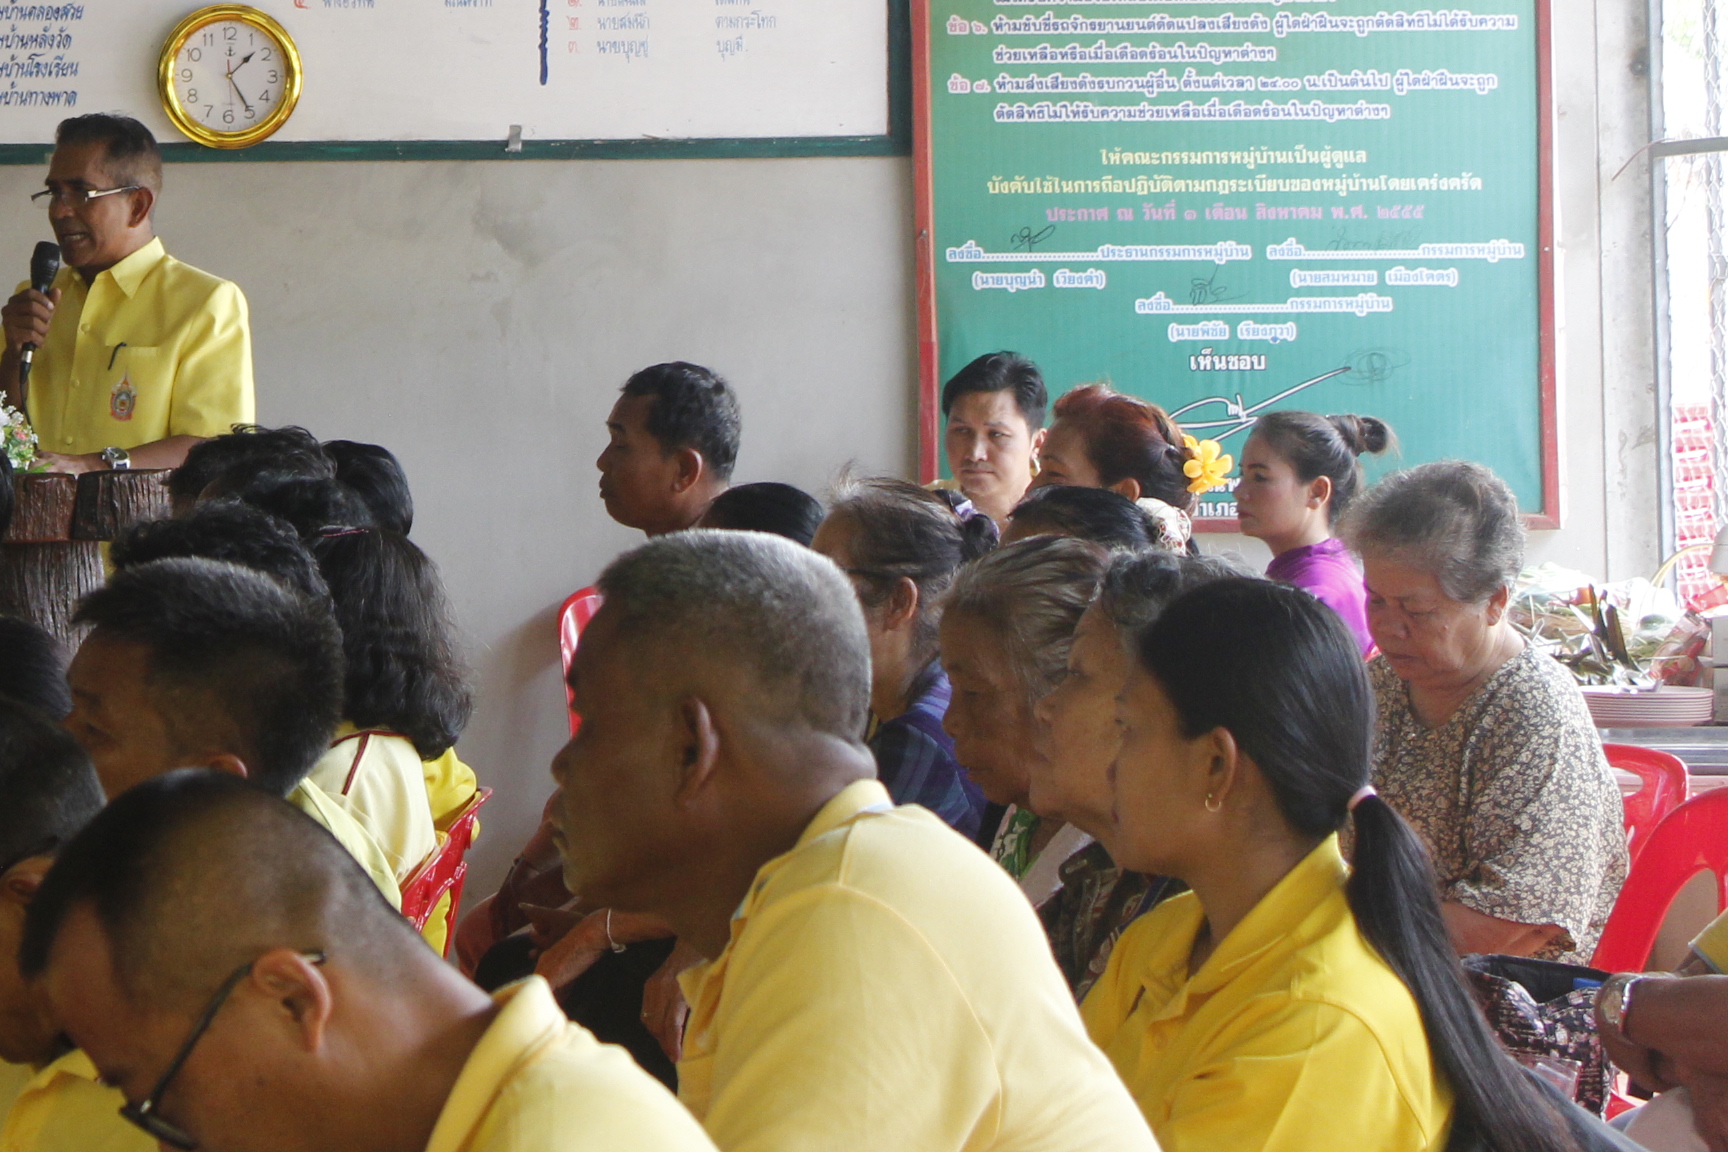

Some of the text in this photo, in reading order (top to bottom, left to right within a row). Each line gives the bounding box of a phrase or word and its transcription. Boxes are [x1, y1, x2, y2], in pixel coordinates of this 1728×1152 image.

[947, 16, 968, 34] ข้อ
[202, 33, 214, 47] 11
[223, 27, 237, 41] 12
[249, 33, 254, 46] 1
[187, 48, 201, 62] 10
[261, 48, 271, 61] 2
[181, 69, 192, 82] 9
[267, 70, 278, 84] 3
[948, 75, 969, 92] ข้อ
[187, 89, 198, 103] 8
[259, 90, 270, 103] 4
[204, 105, 213, 118] 7
[223, 110, 234, 124] 6
[244, 106, 255, 119] 5
[1046, 199, 1426, 222] ประกาศ ณ วันที่ ๑ เดือน สิงหาคม พ.ศ. ๒๕๕๕
[1190, 348, 1266, 371] เห็นชอบ
